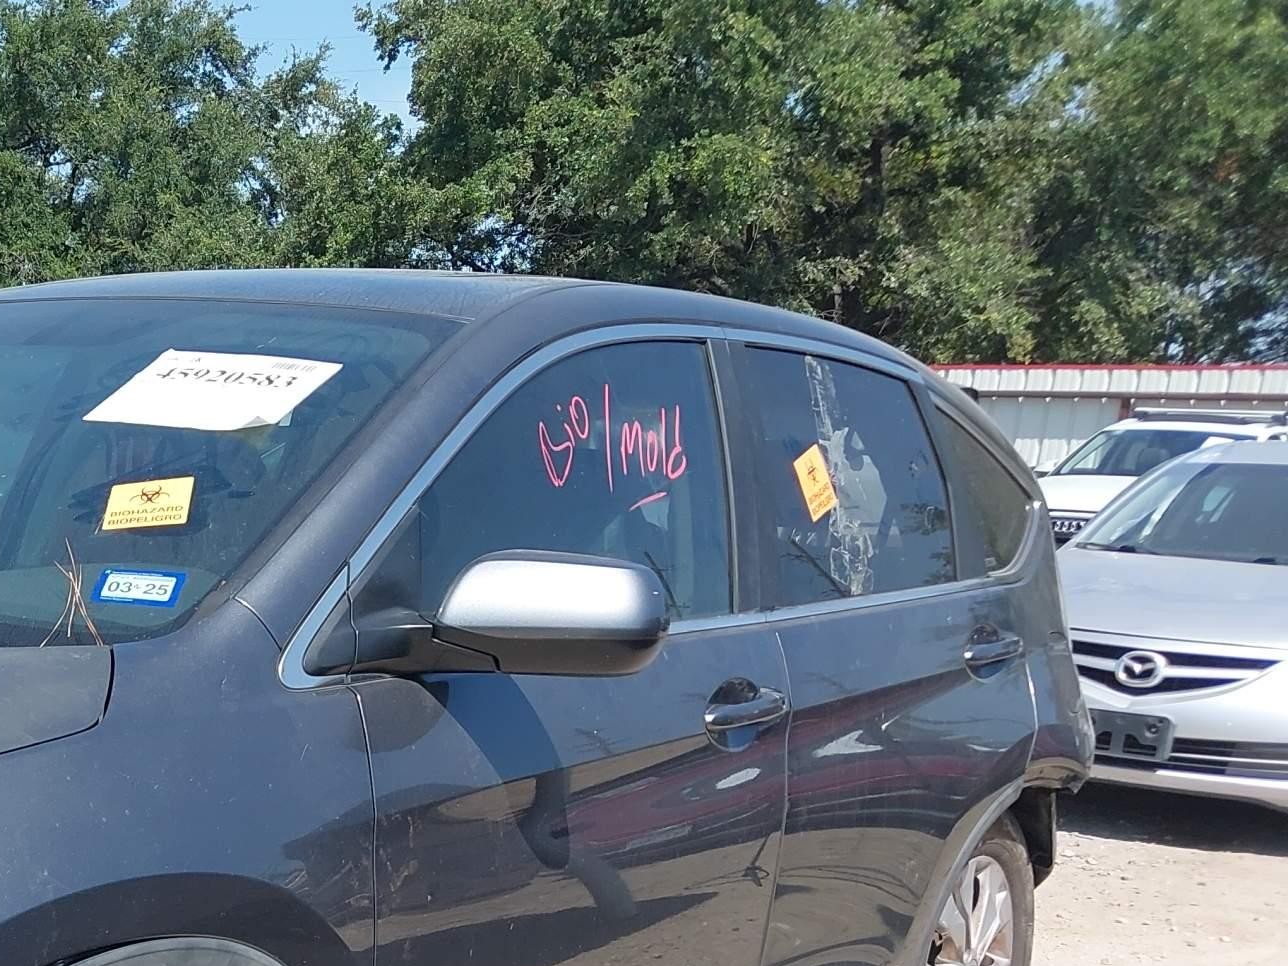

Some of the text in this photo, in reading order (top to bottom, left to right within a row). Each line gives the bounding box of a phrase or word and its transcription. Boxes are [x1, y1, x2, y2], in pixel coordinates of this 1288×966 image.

[155, 366, 298, 389] 45920583
[110, 505, 184, 518] BIOHAZARD
[107, 513, 183, 526] BIOPELIGRO
[107, 580, 169, 596] 03 25
